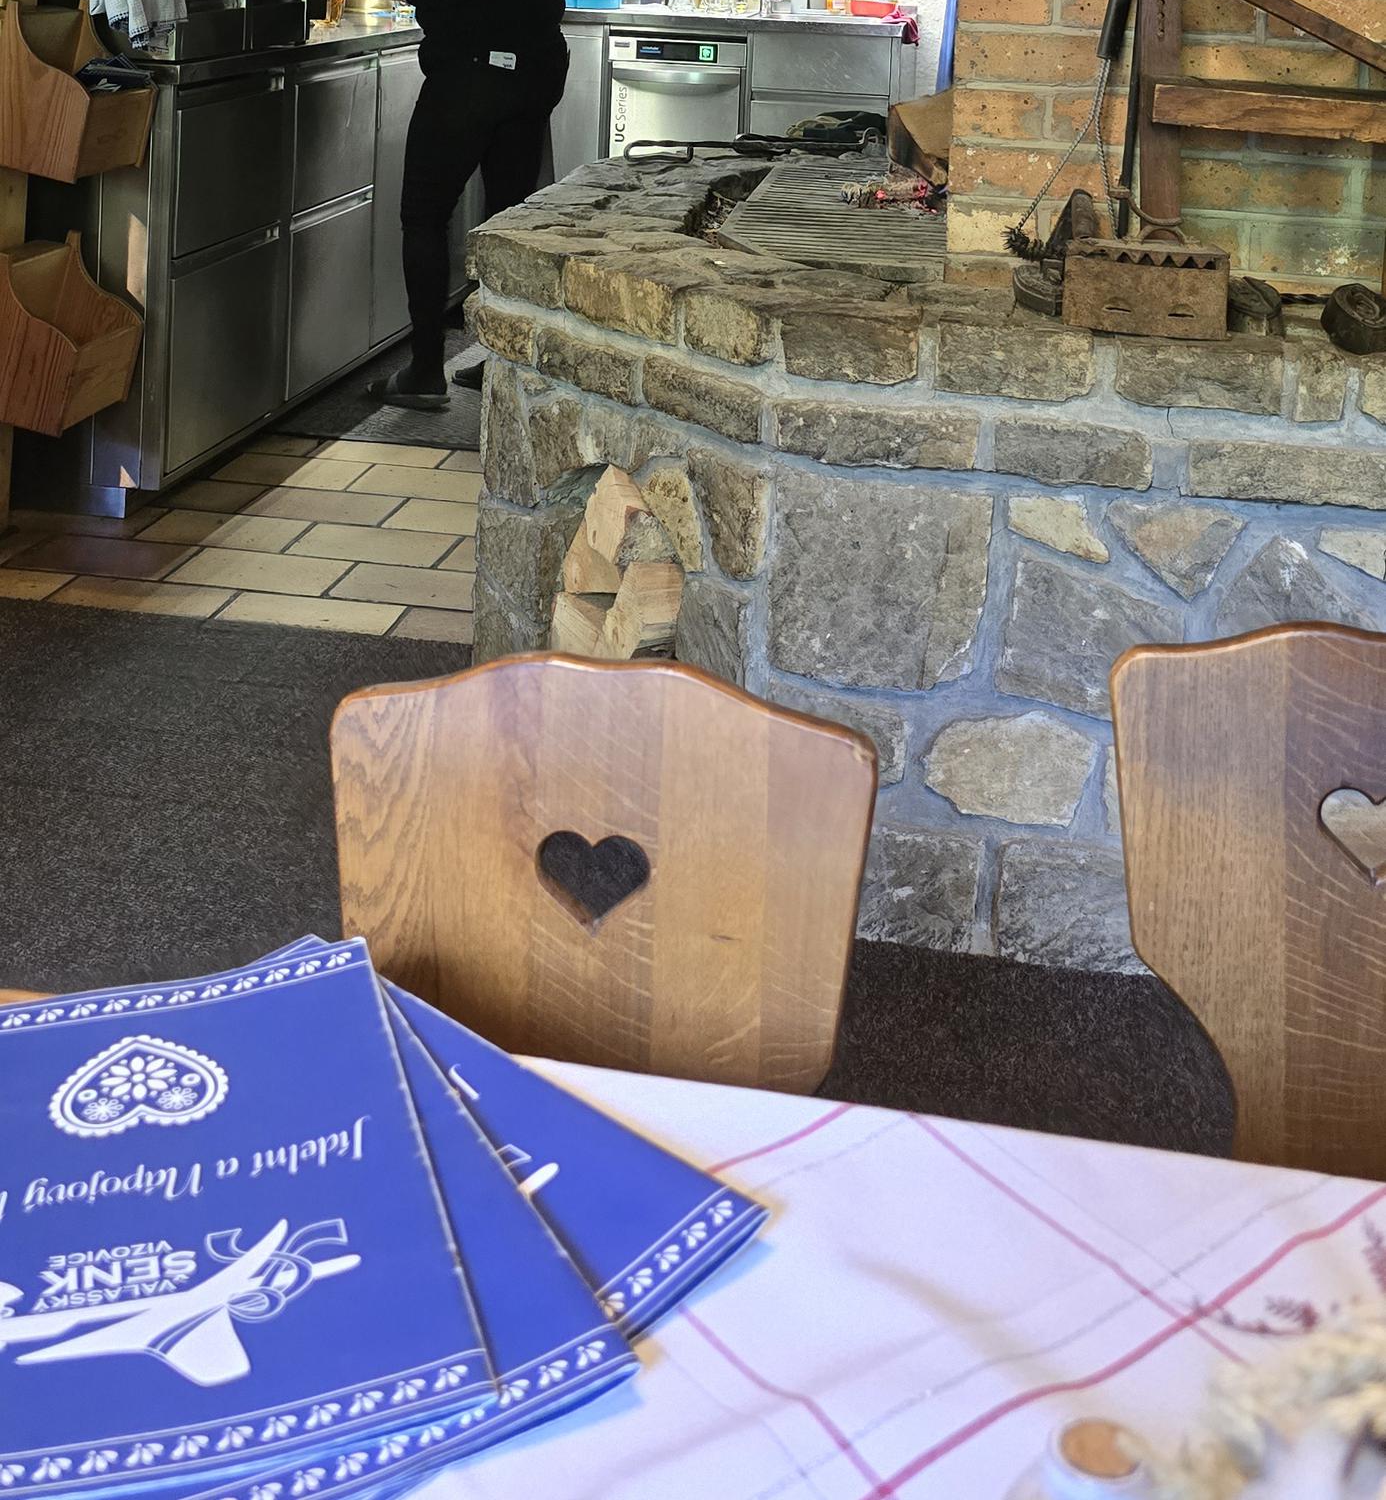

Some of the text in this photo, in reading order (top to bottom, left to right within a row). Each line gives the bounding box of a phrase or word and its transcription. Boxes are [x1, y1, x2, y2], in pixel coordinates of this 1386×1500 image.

[615, 86, 628, 142] UC Series
[250, 1115, 371, 1176] Jídelní
[22, 1162, 203, 1212] Nápojový
[216, 1157, 238, 1179] a
[39, 1251, 197, 1295] ŠENK
[49, 1240, 173, 1268] VIZOVICE
[32, 1278, 178, 1312] VALAŠSKÝ
